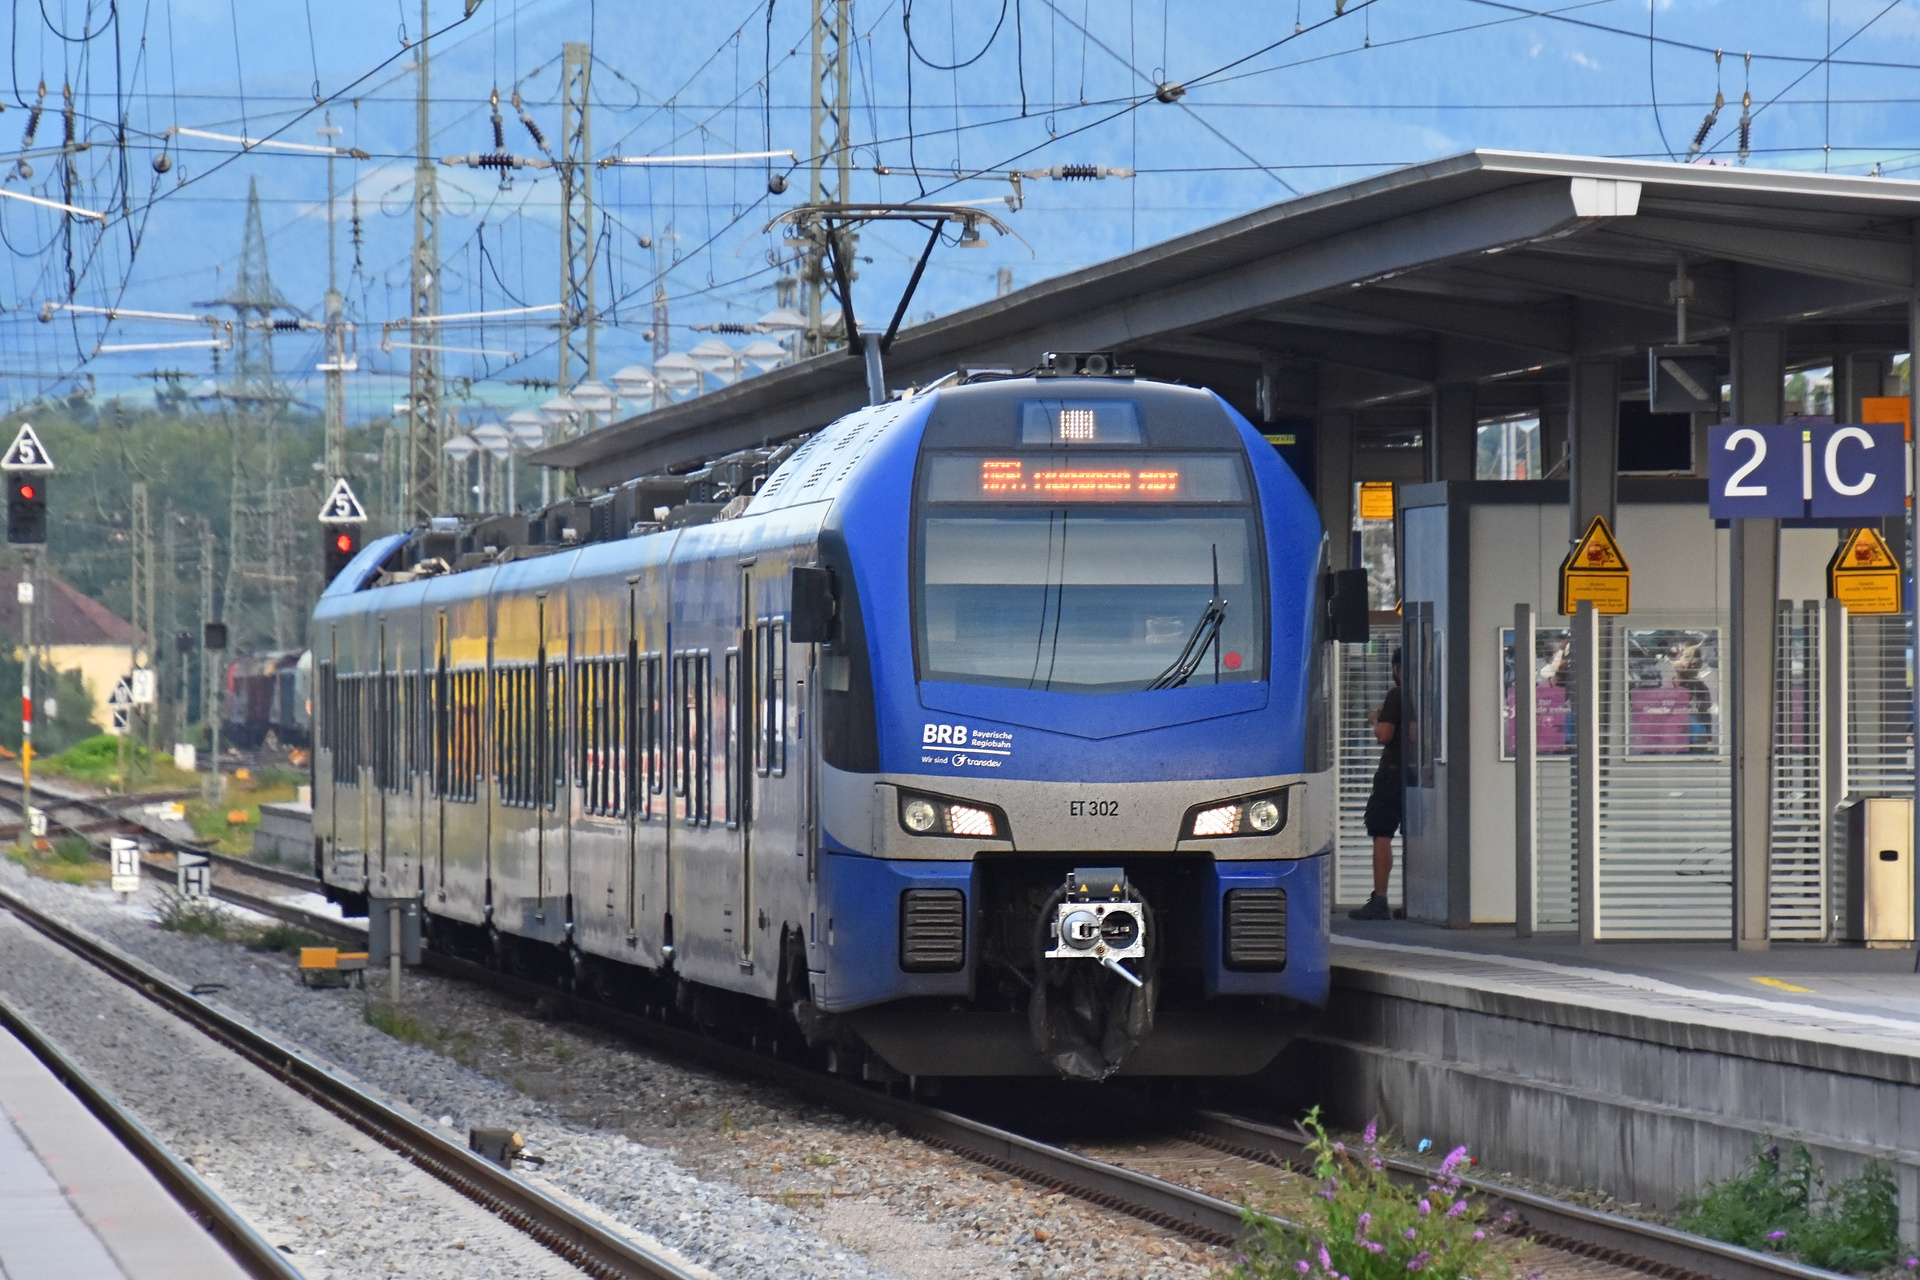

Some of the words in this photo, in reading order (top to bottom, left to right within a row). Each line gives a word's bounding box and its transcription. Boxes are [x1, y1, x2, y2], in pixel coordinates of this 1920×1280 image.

[19, 439, 36, 464] 5
[1724, 429, 1767, 497] 2
[1824, 427, 1877, 496] C
[335, 493, 351, 516] 5
[923, 723, 968, 745] BRB
[971, 738, 1011, 748] Regiobahn
[972, 729, 1013, 740] Bayerische
[934, 756, 948, 764] sind
[967, 758, 1002, 768] transdev
[1070, 800, 1086, 816] ET
[1089, 800, 1119, 816] 302
[117, 850, 133, 874] H
[184, 867, 203, 895] H
